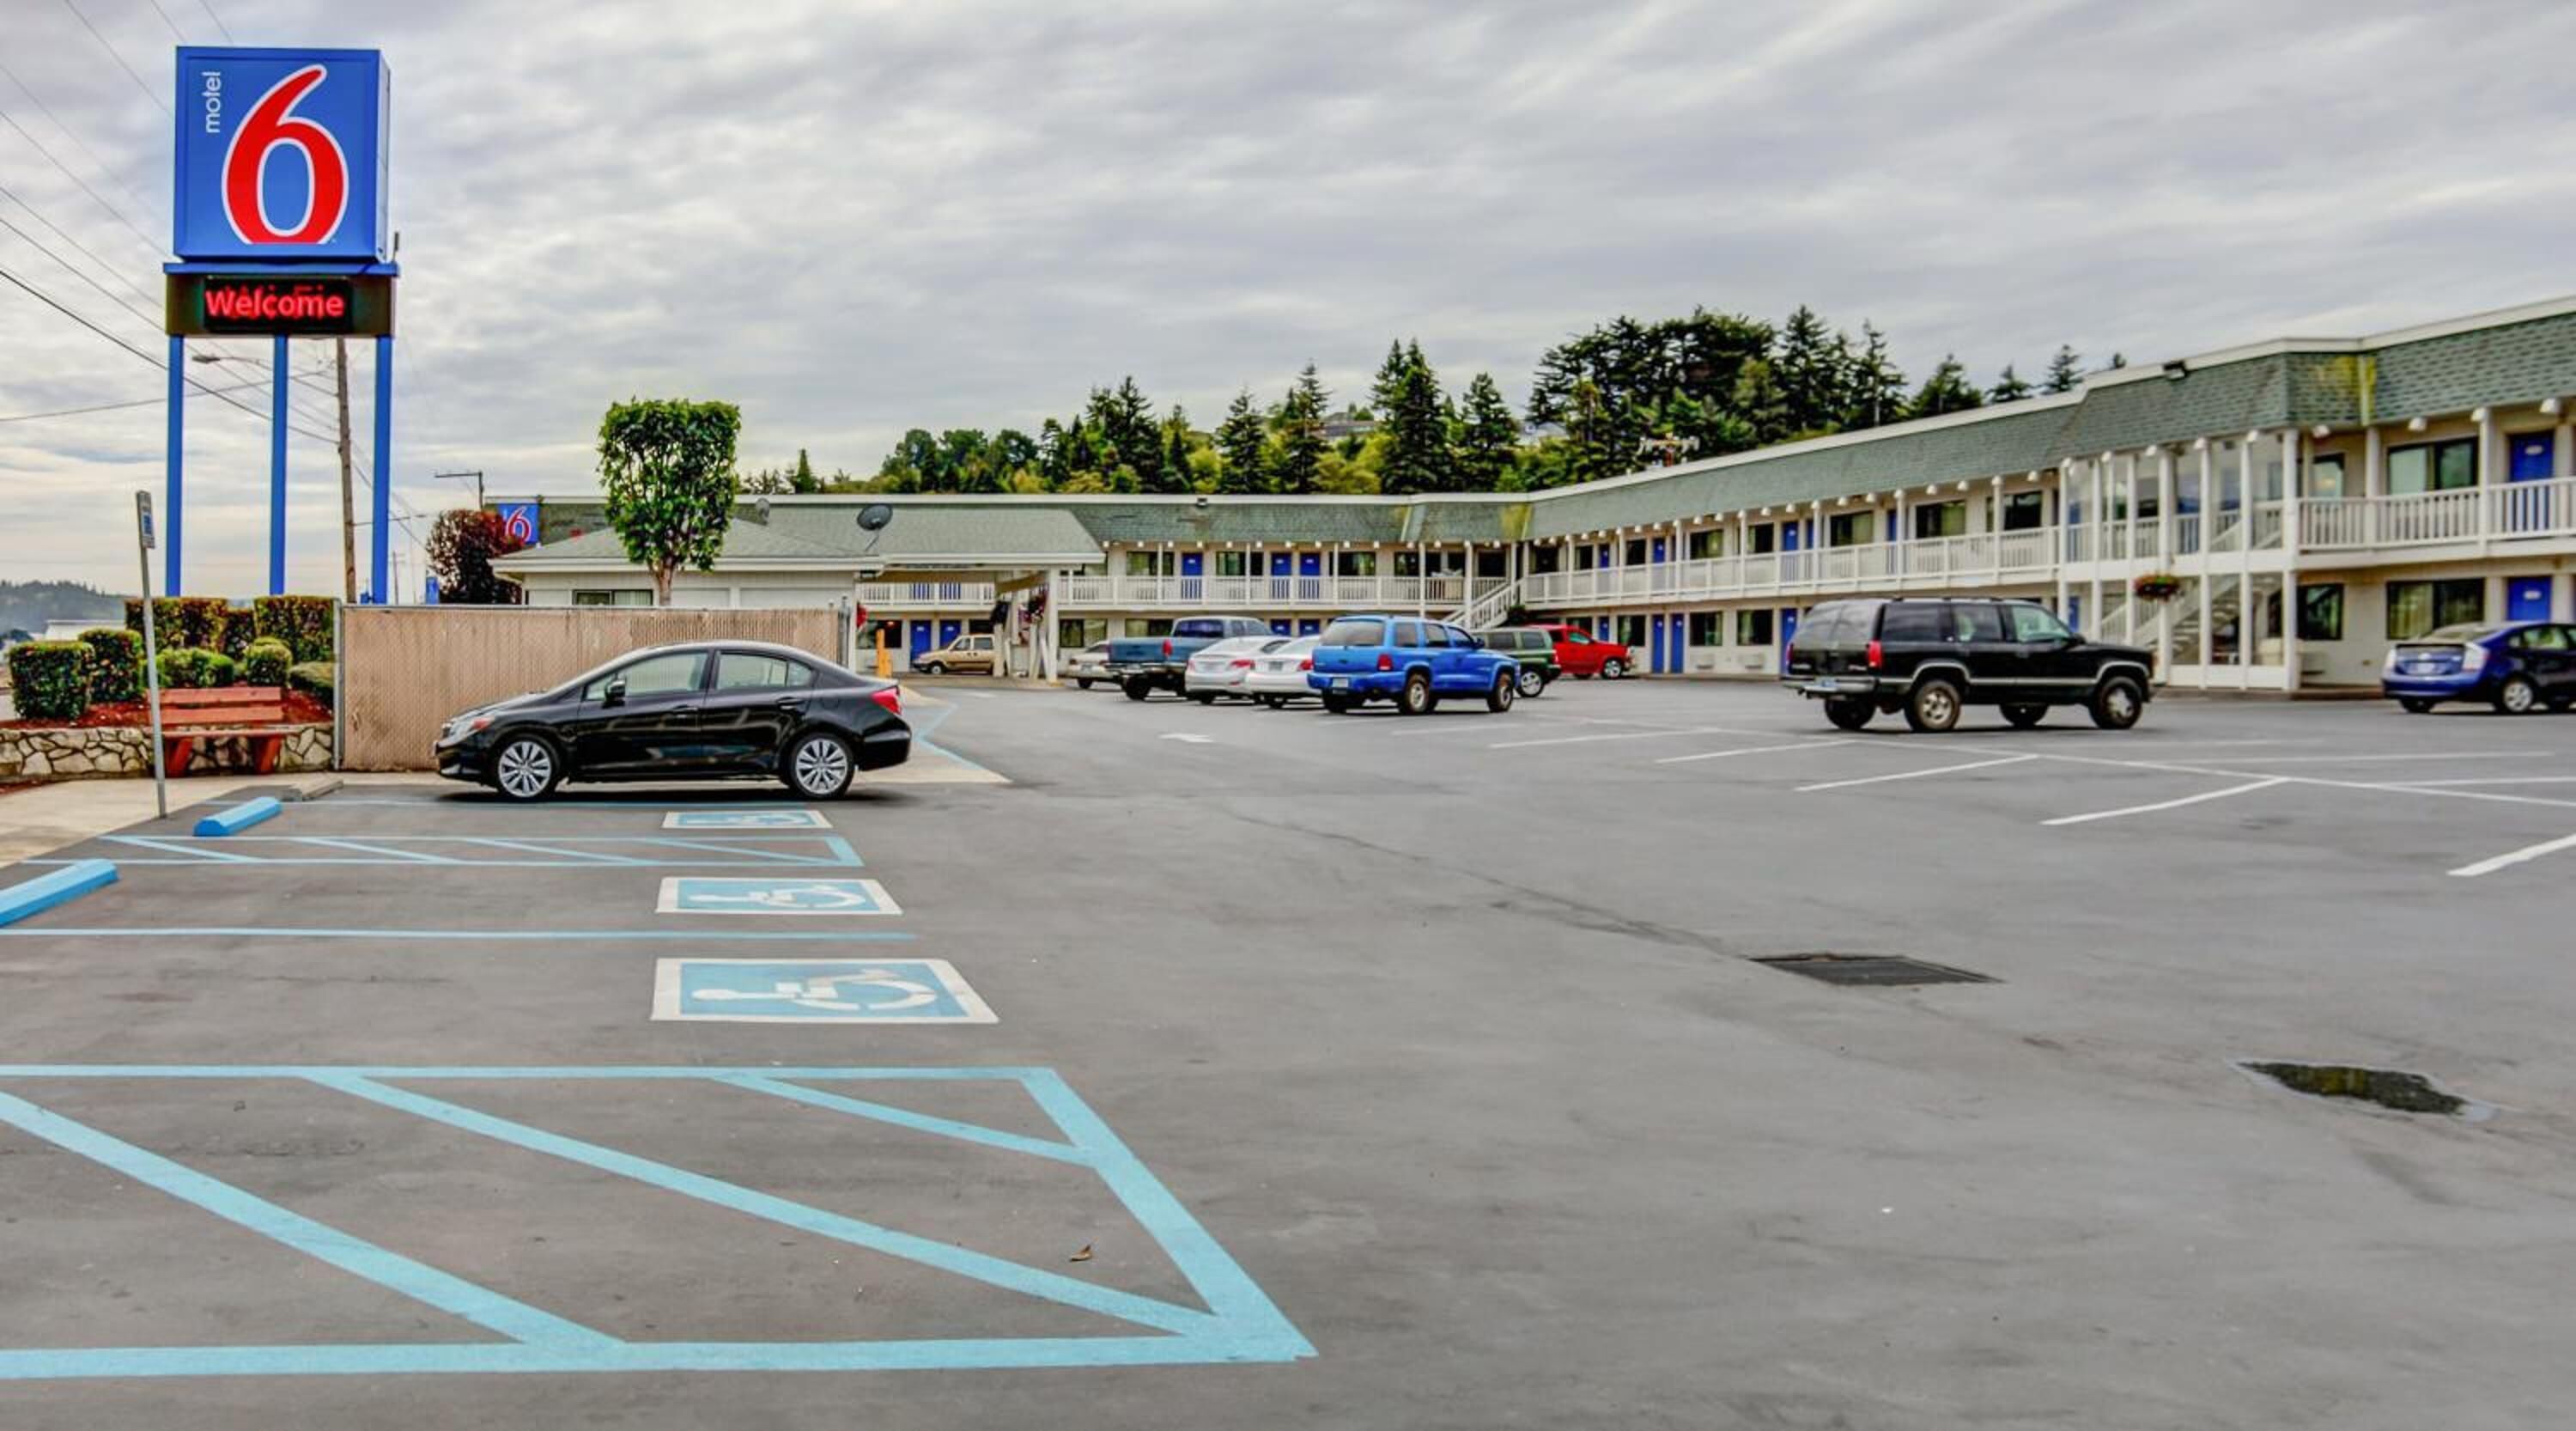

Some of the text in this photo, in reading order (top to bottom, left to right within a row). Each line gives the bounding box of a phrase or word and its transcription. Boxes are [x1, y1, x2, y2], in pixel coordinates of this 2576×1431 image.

[201, 71, 221, 133] motel
[222, 64, 349, 244] 6
[205, 288, 344, 317] Welcome
[505, 505, 532, 542] 6
